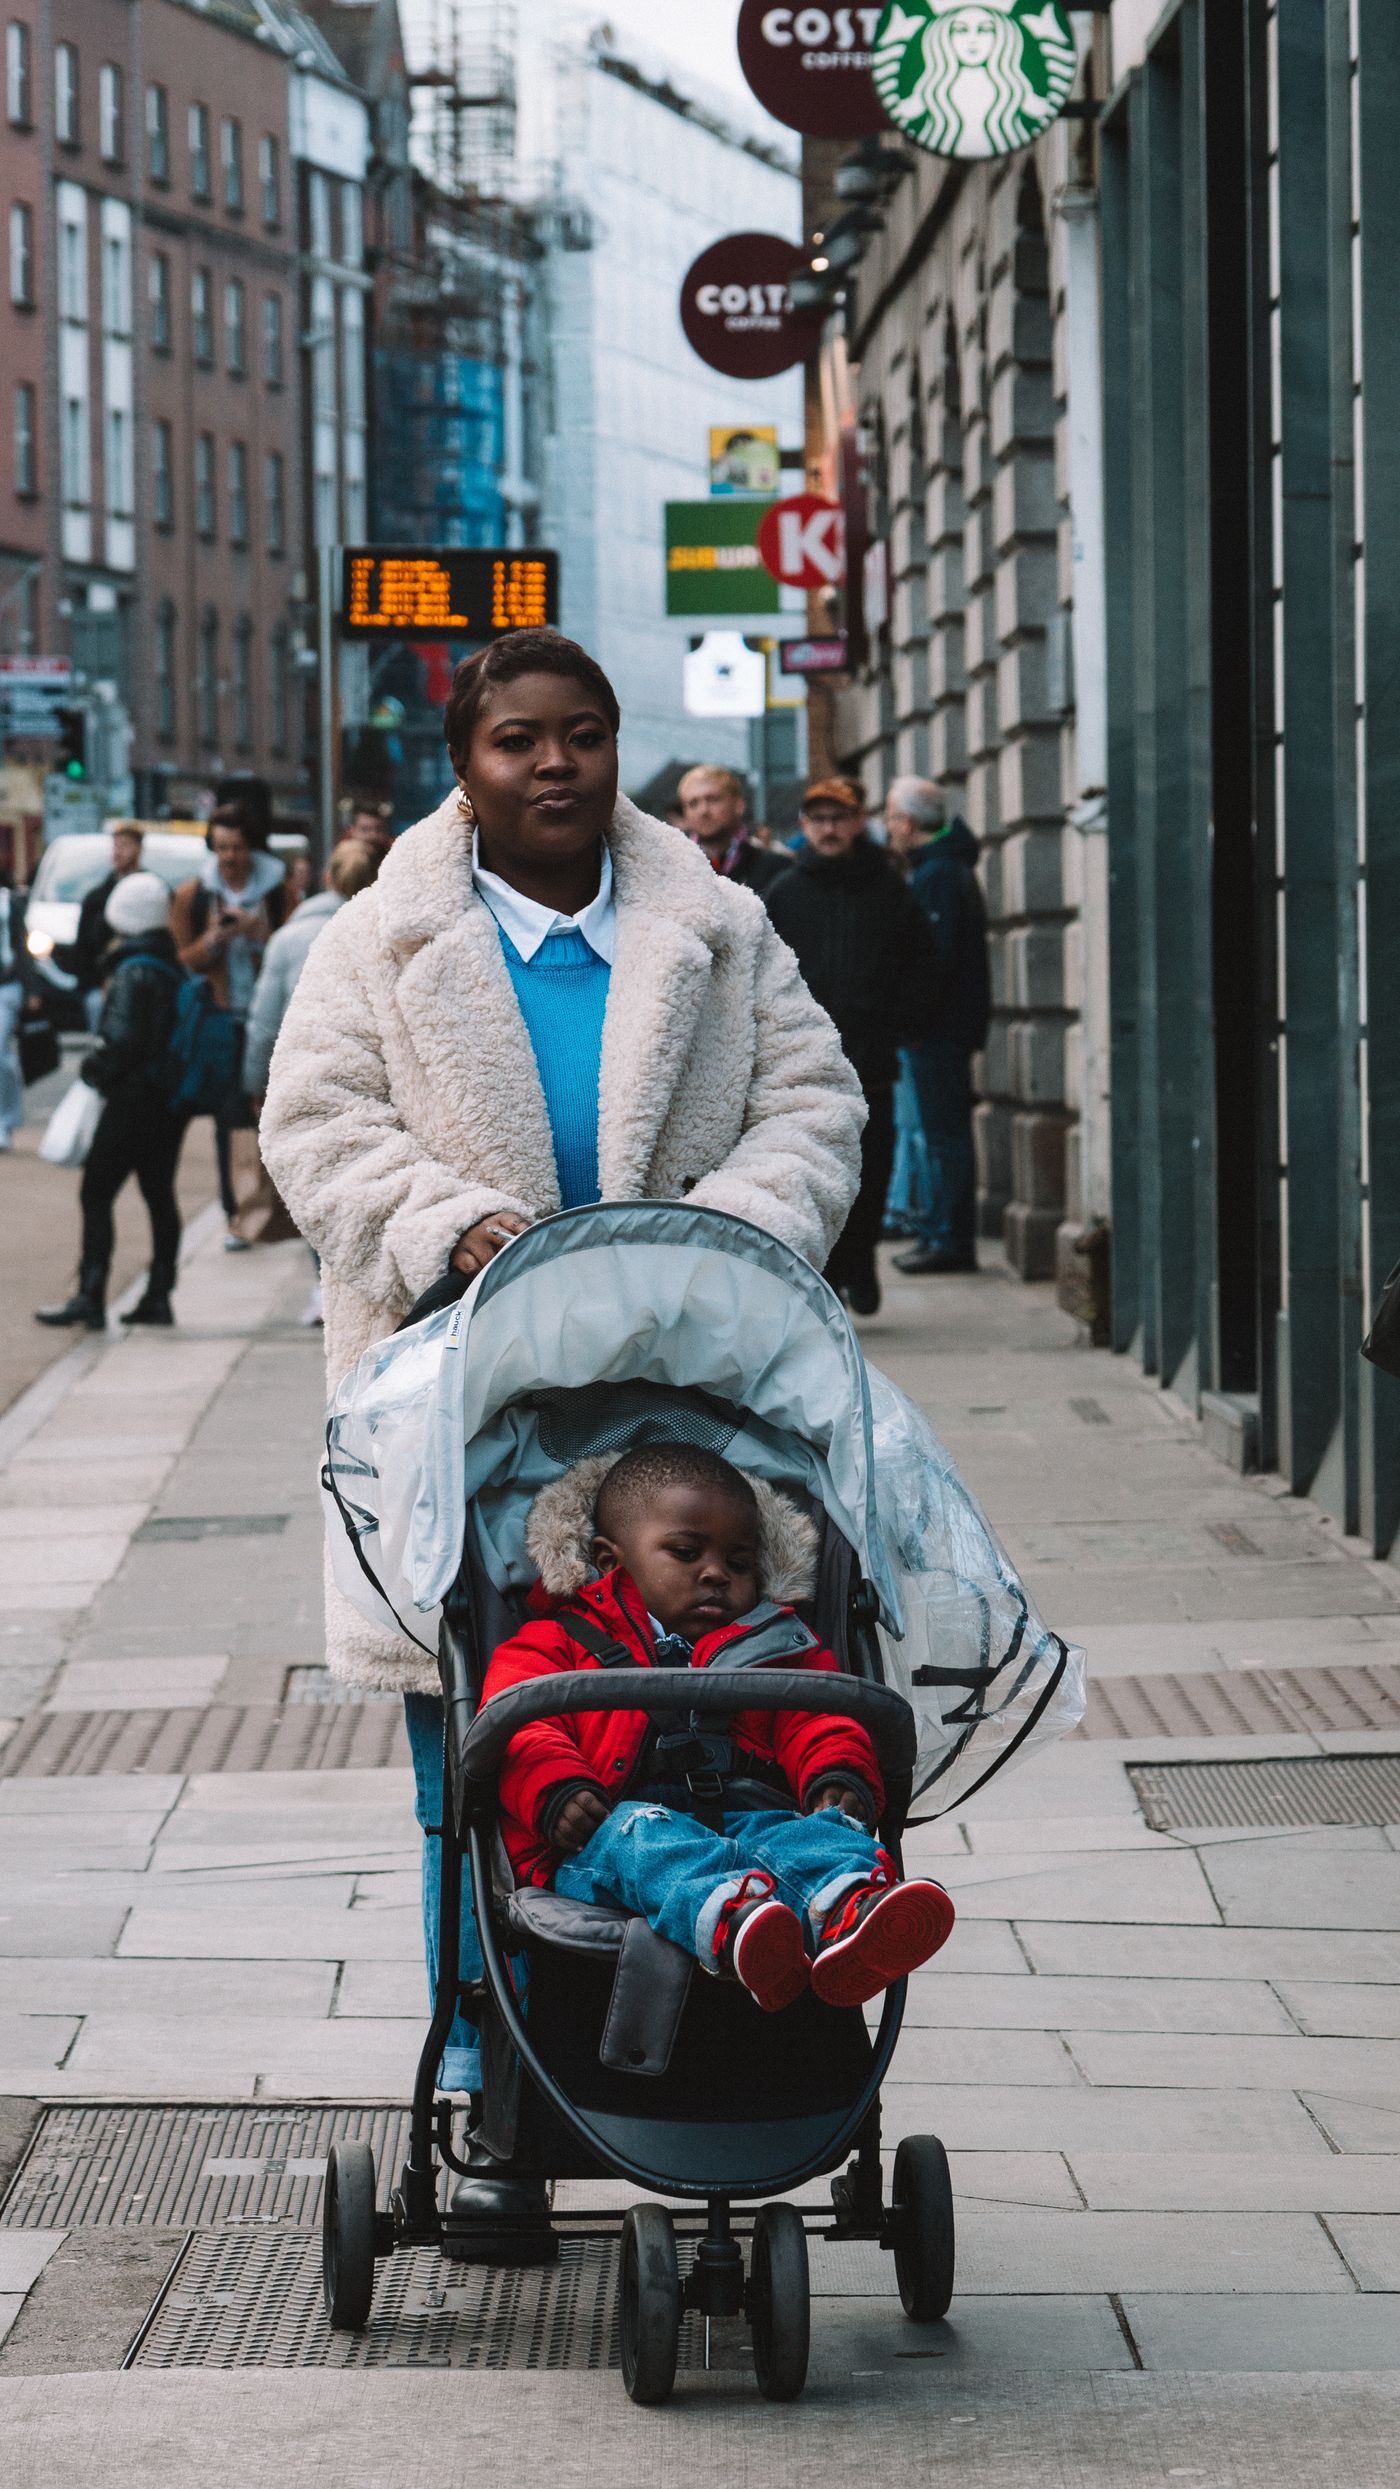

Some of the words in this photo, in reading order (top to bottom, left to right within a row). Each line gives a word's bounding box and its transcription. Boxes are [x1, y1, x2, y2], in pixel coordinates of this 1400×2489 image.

[761, 7, 883, 50] COST
[777, 510, 845, 581] K
[451, 1311, 462, 1336] hauck
